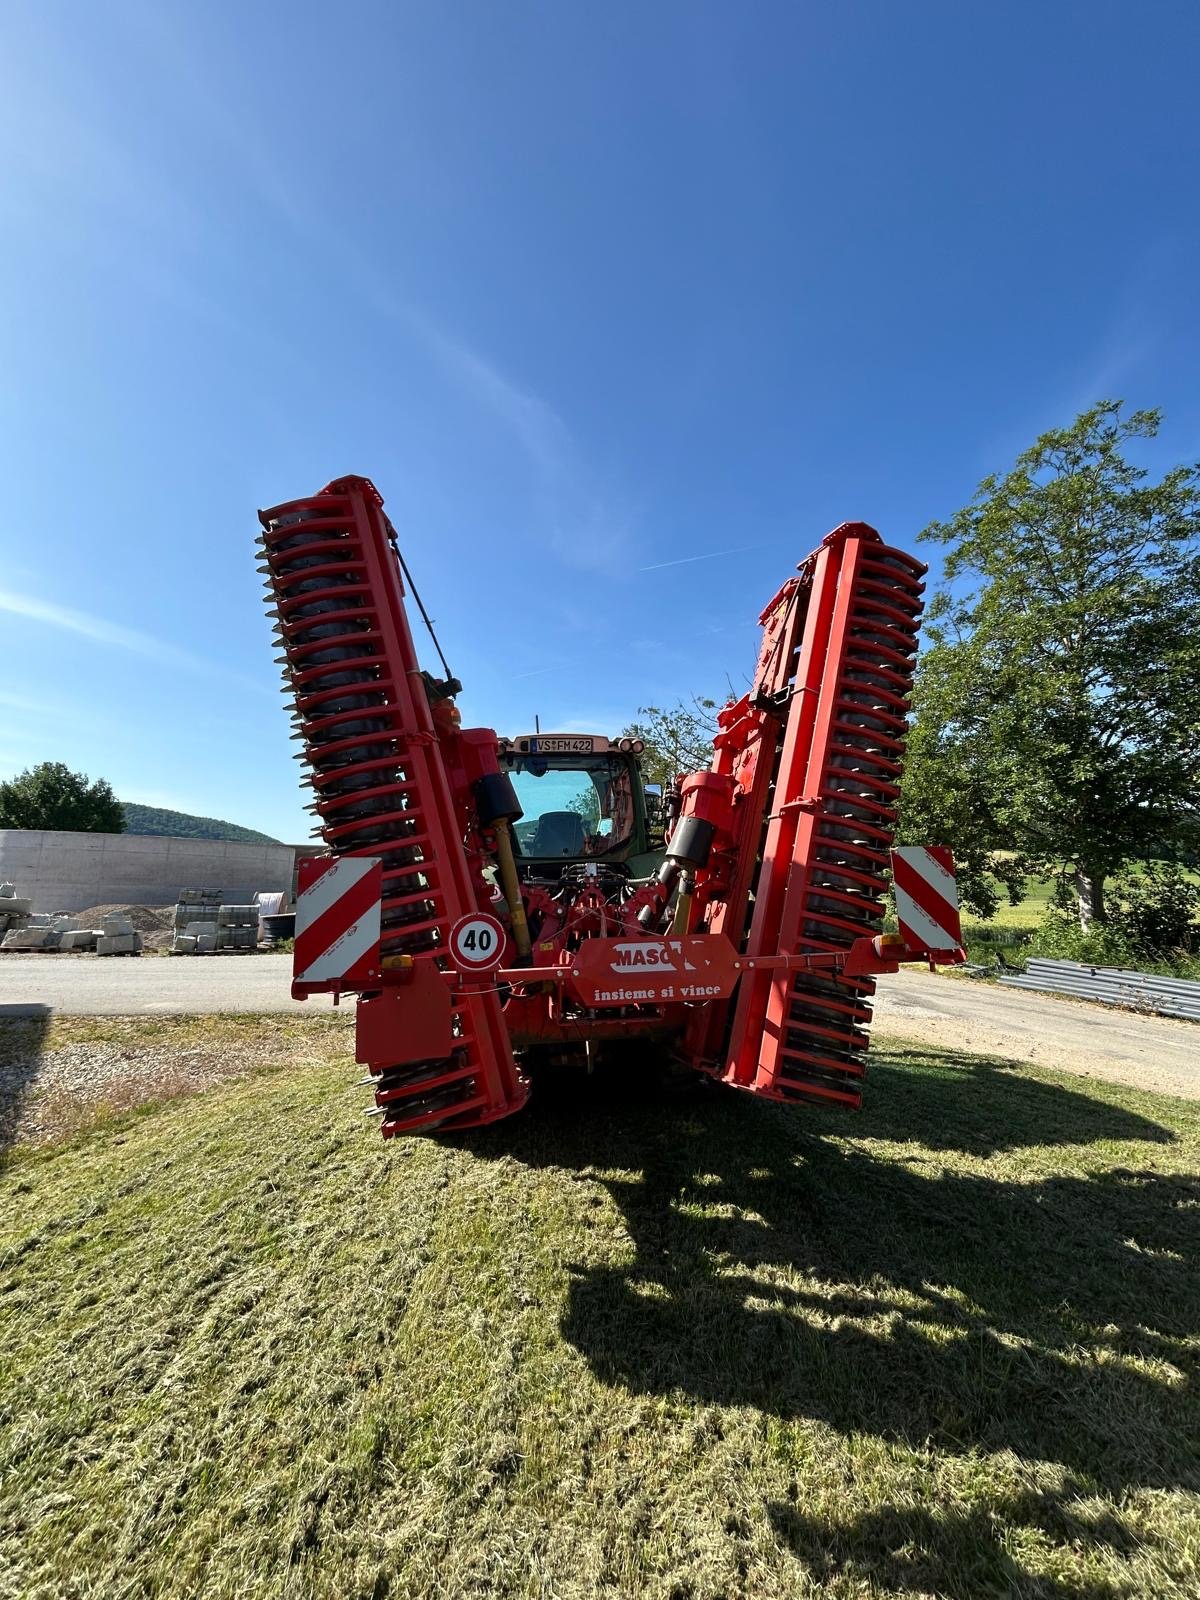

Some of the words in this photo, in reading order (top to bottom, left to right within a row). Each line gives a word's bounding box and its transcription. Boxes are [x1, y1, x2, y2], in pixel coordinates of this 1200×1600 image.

[538, 740, 550, 750] VS
[573, 740, 591, 750] 422
[464, 929, 491, 951] 40
[594, 989, 655, 1001] insieme
[661, 986, 674, 998] si
[680, 985, 720, 996] vince
